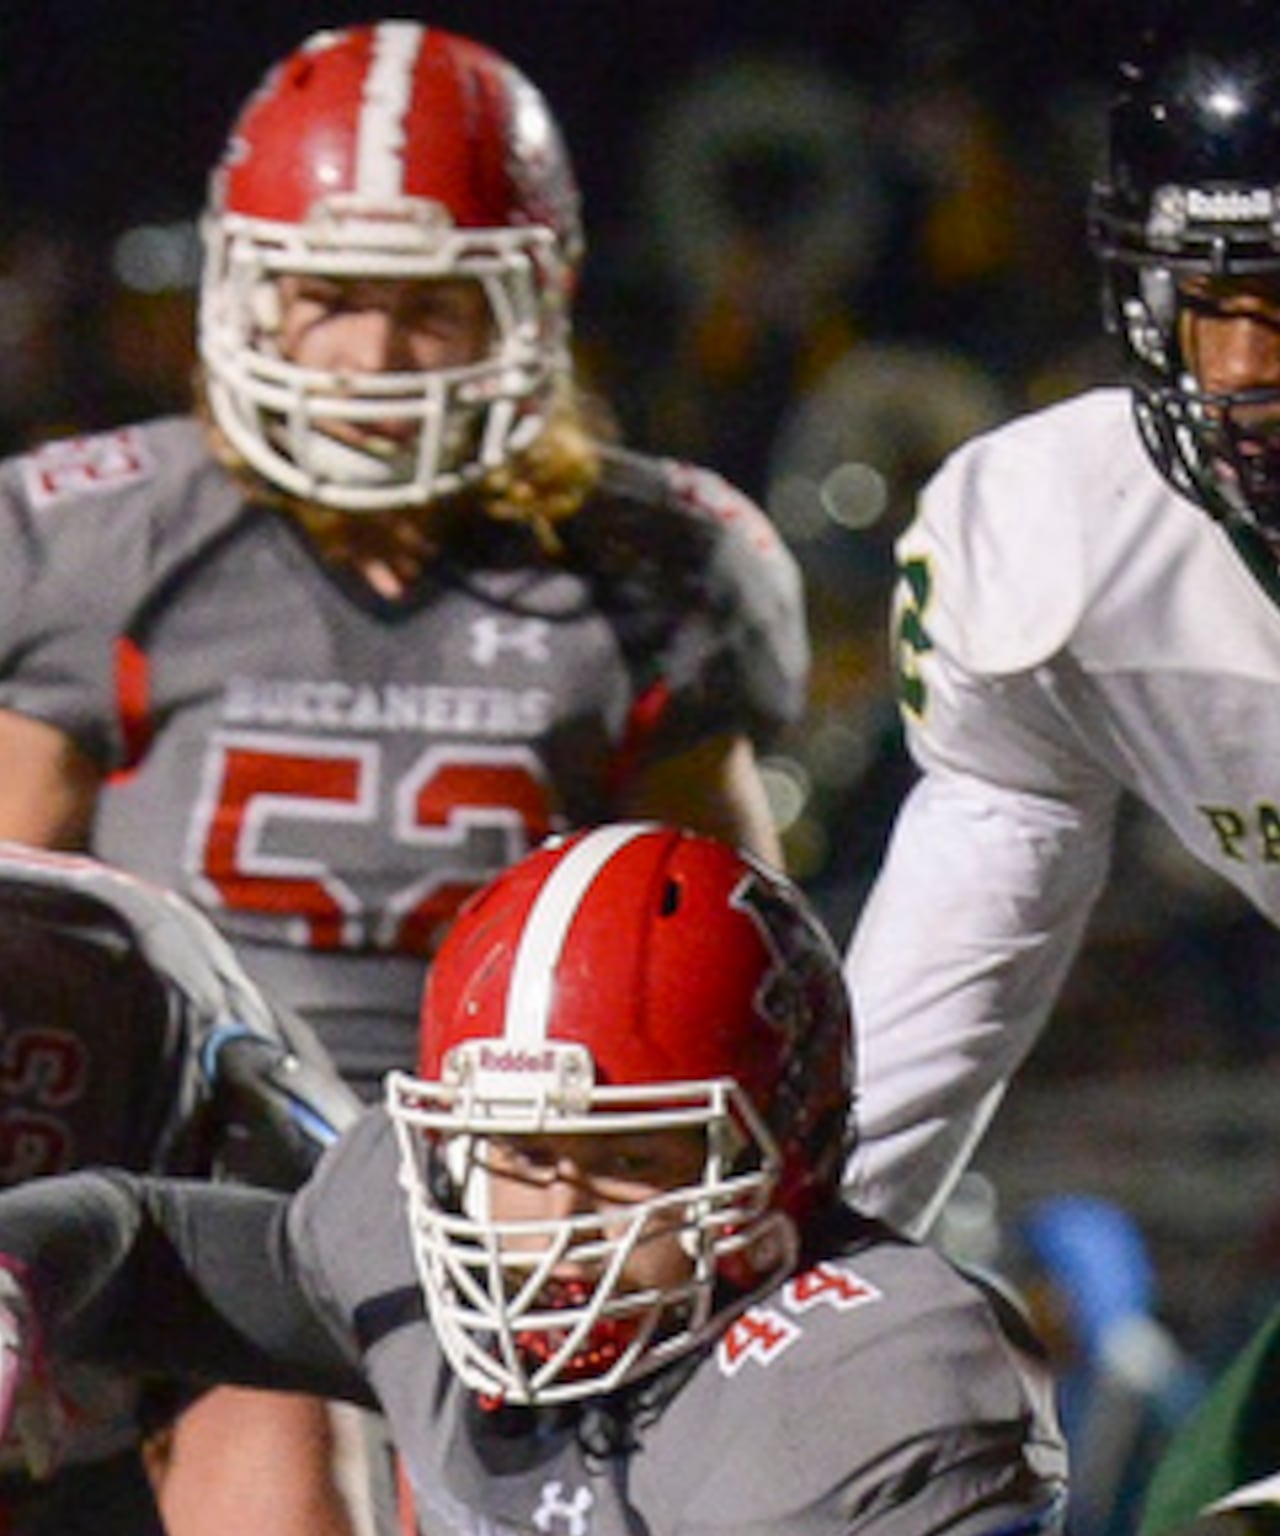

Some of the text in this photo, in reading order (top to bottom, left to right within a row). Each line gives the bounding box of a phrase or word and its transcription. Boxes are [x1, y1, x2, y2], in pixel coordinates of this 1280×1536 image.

[222, 674, 558, 736] BUCCANEERS
[479, 1045, 556, 1074] Riddell
[718, 1261, 885, 1378] 44
